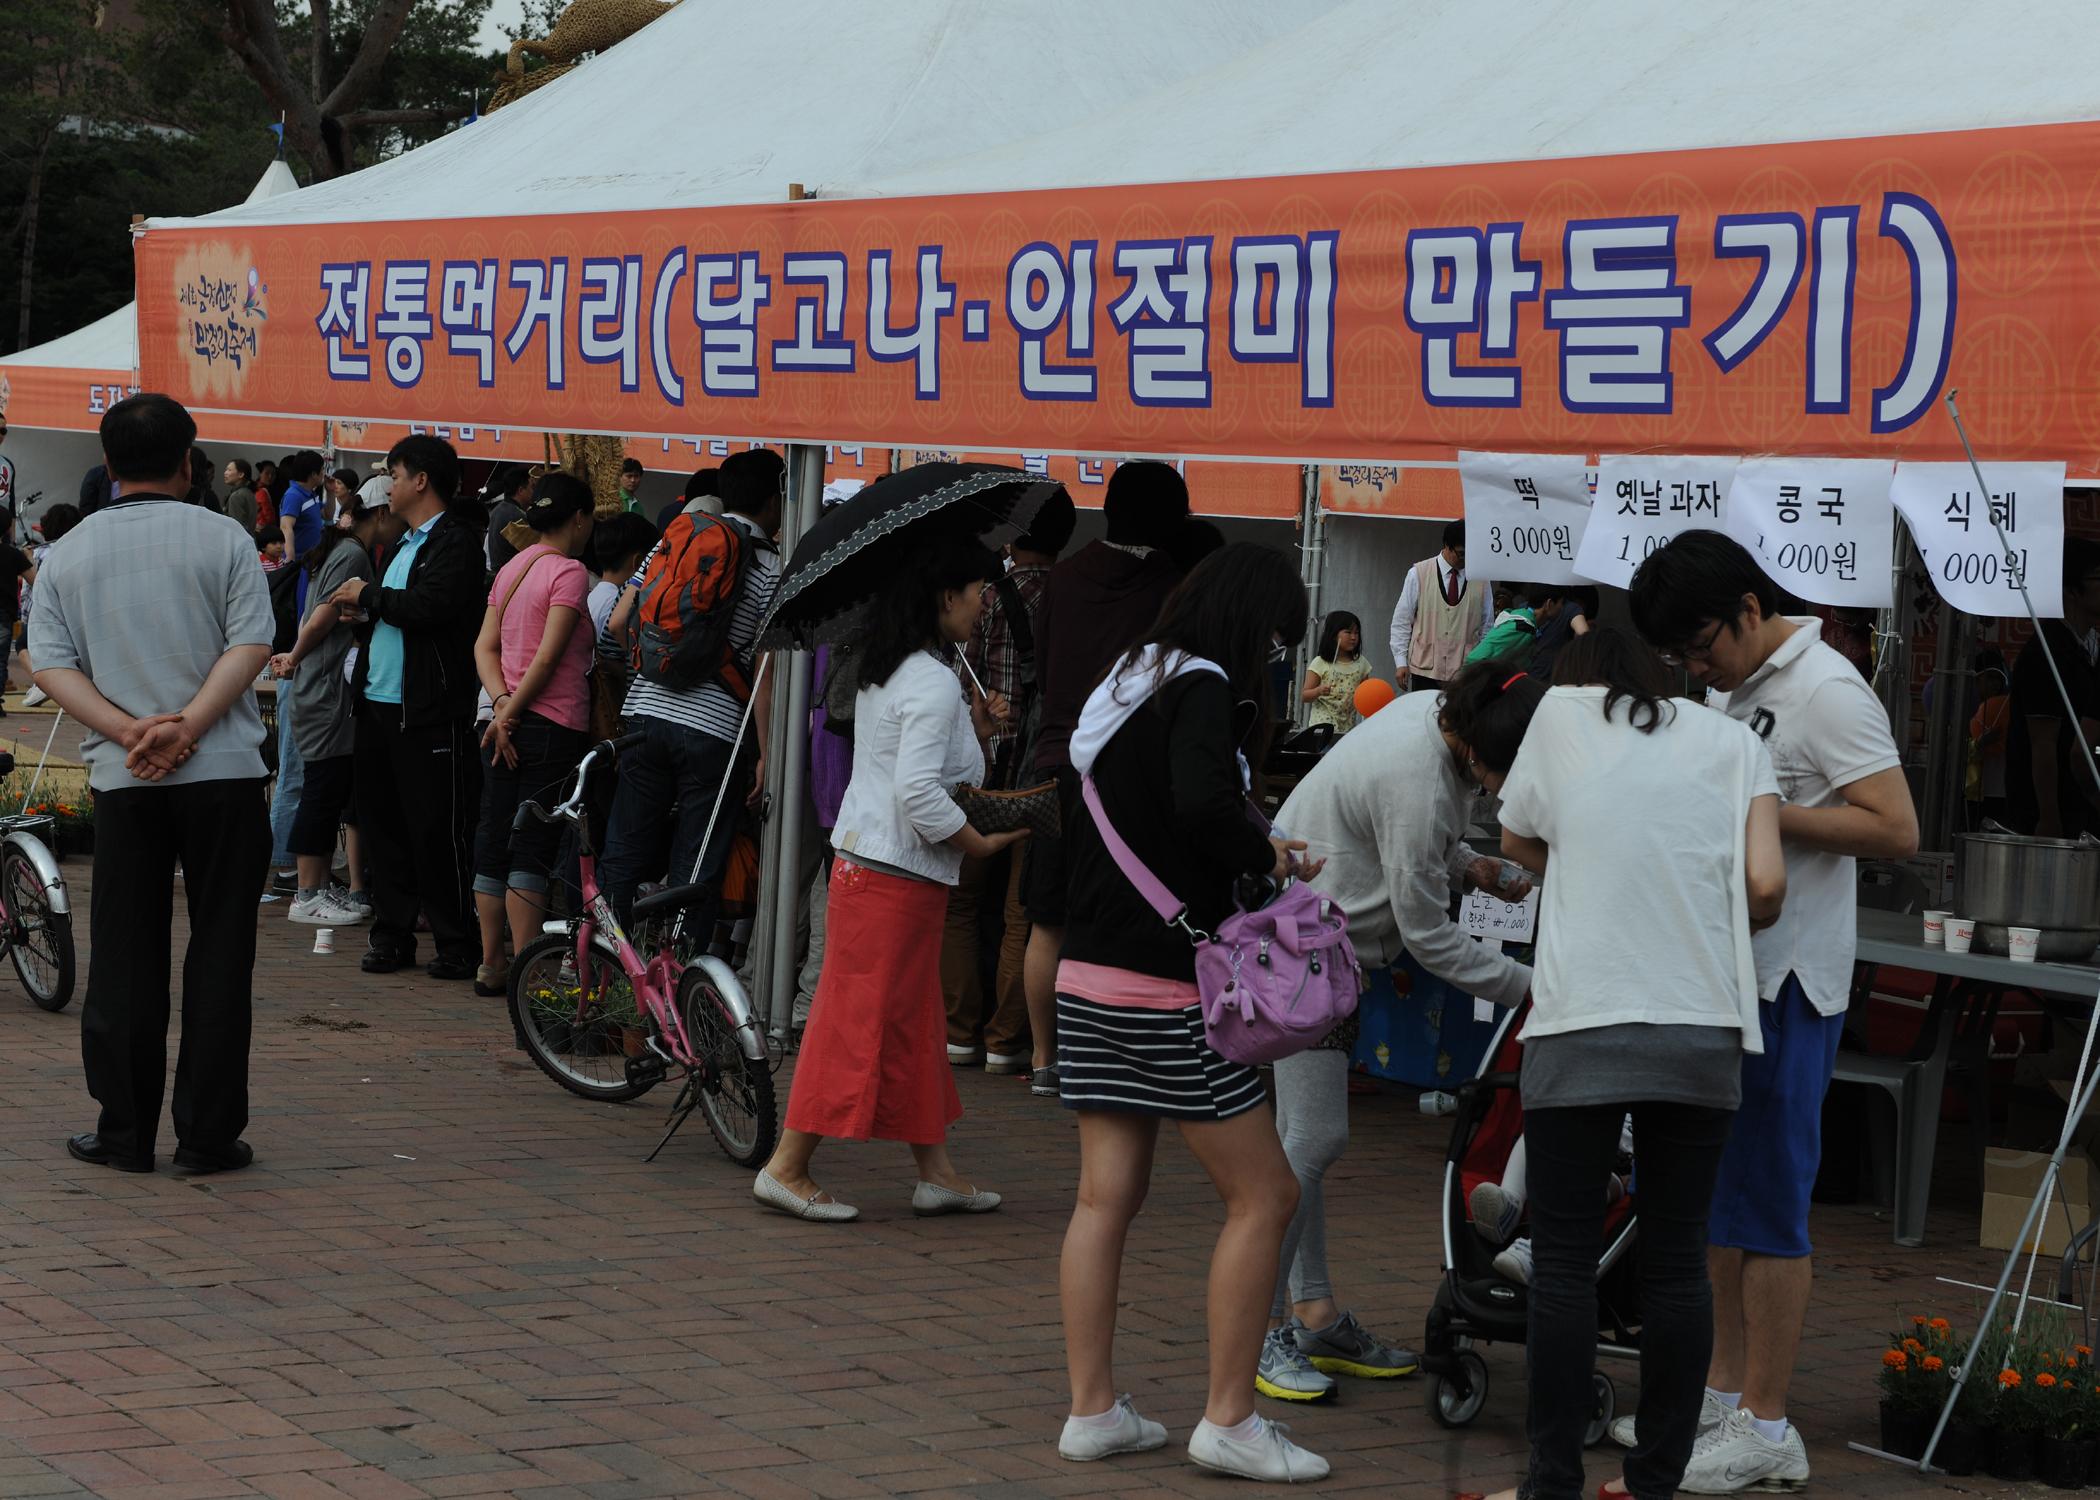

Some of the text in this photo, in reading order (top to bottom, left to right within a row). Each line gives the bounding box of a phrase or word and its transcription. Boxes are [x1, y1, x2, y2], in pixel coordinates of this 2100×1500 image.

[197, 274, 238, 314] 금정산성
[1403, 190, 1957, 434] 만들기)
[1513, 477, 1540, 510] 떡
[1616, 479, 1663, 516] 옛날
[1669, 480, 1721, 517] 과자
[1490, 525, 1574, 561] 3.000원
[1921, 548, 2028, 590] .000원
